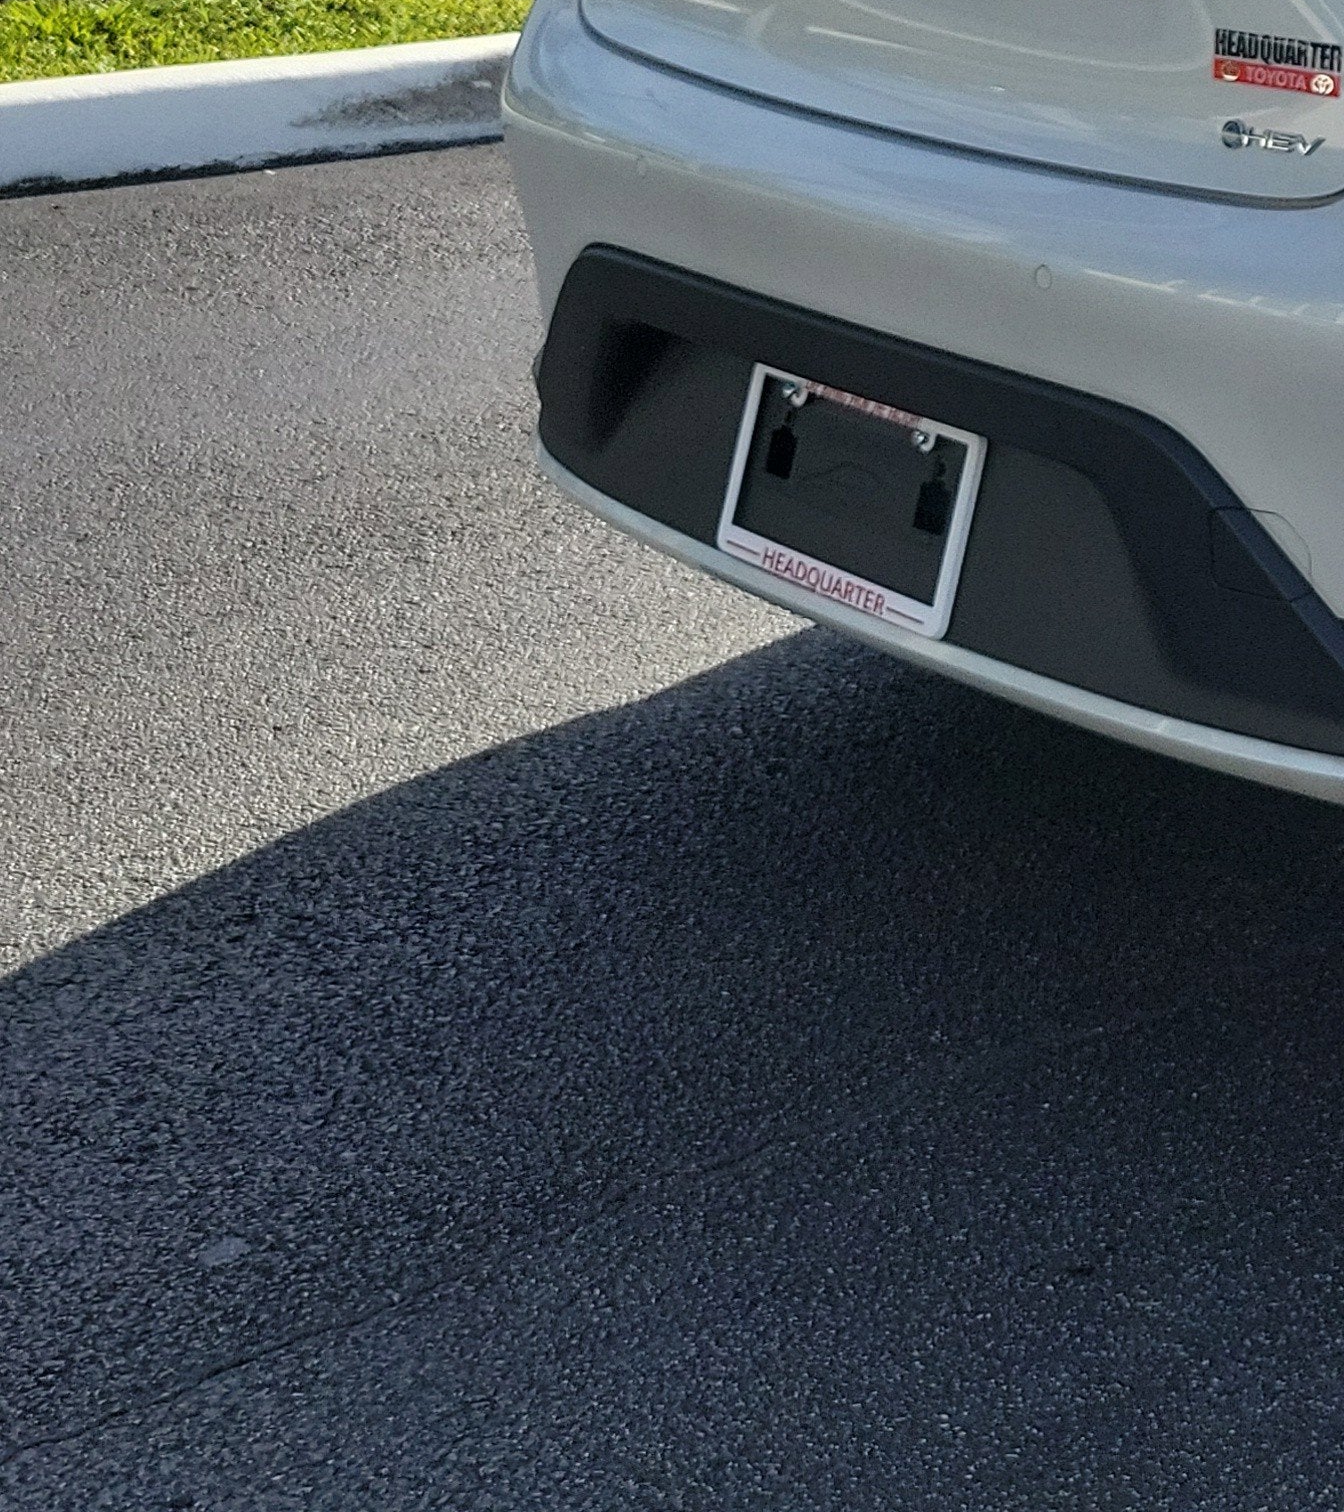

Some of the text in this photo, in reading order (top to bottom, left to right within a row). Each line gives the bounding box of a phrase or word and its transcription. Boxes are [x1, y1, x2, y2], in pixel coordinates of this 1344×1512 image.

[1214, 28, 1343, 73] HEADQUARTER
[1245, 66, 1308, 91] TOYOTA
[760, 546, 888, 617] HEADQUARTER
